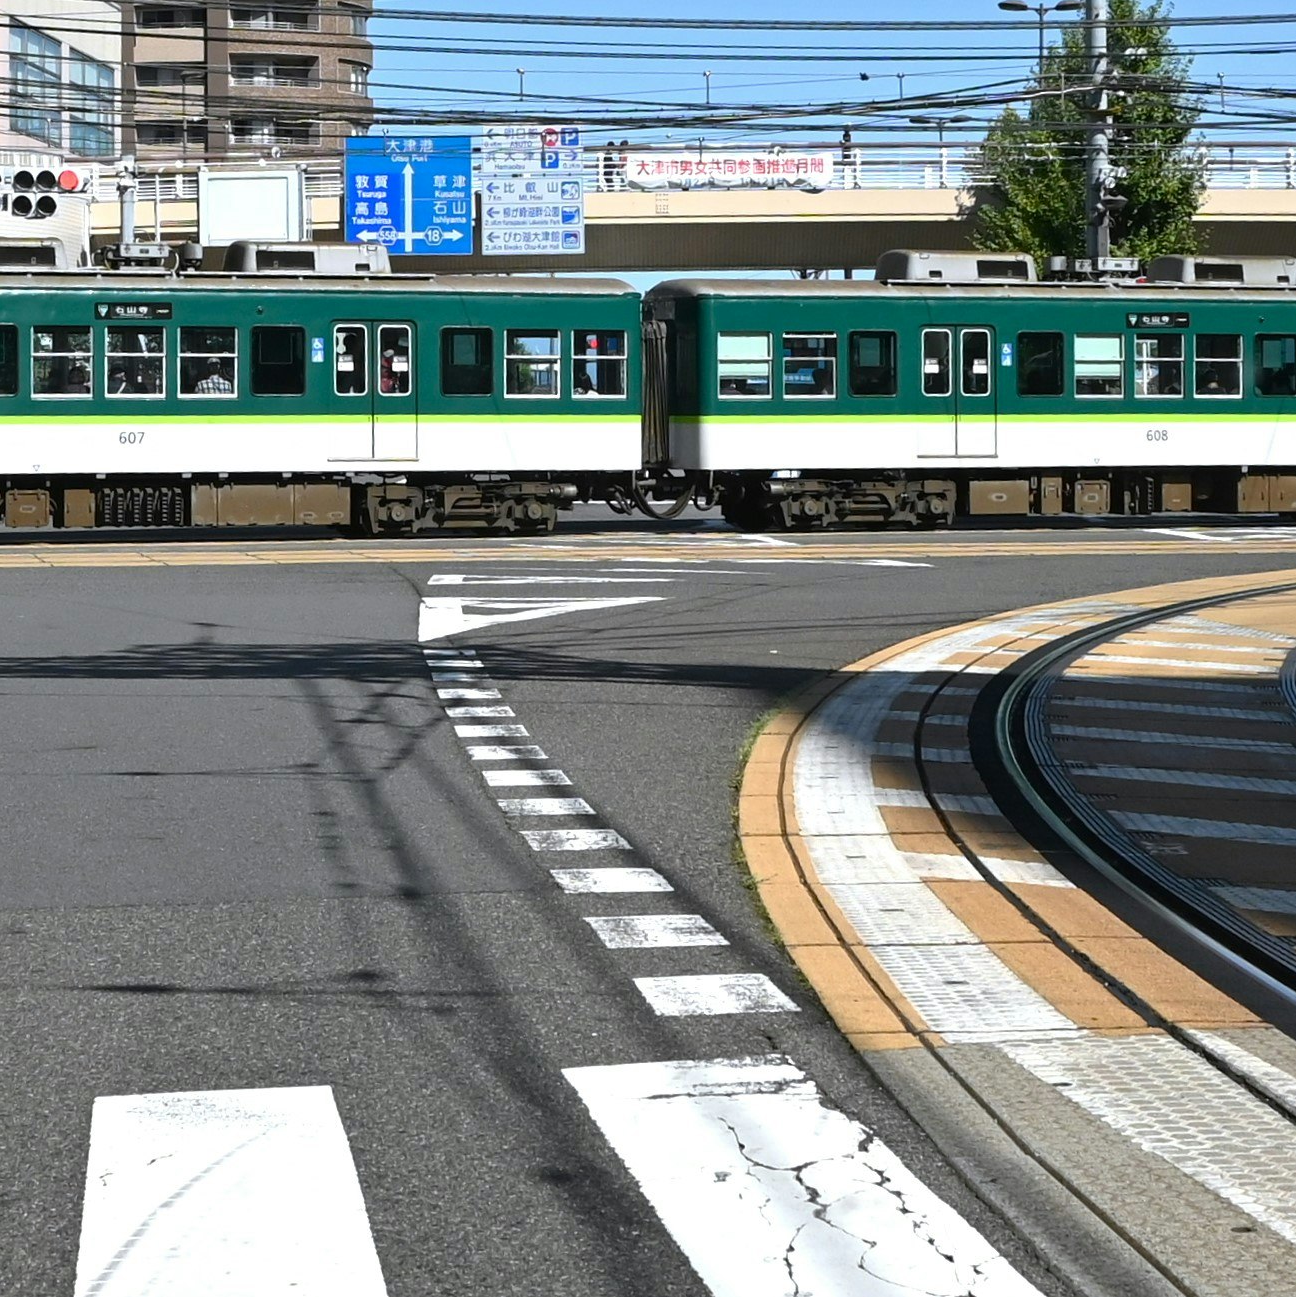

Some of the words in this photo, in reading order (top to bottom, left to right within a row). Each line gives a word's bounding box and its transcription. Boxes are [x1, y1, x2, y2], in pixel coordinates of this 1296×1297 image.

[386, 139, 434, 153] 大津港
[636, 158, 824, 177] 大津市男女共同参画推進月間
[355, 175, 389, 189] 敦賀
[433, 175, 467, 189] 草津
[503, 182, 559, 193] 比叡山
[355, 202, 389, 216] 高島
[433, 201, 466, 215] 石山
[433, 216, 467, 225] Ishiyama
[427, 229, 439, 242] 18
[503, 231, 560, 243] びわ湖大津館
[119, 431, 145, 444] 607
[1146, 429, 1168, 442] 608
